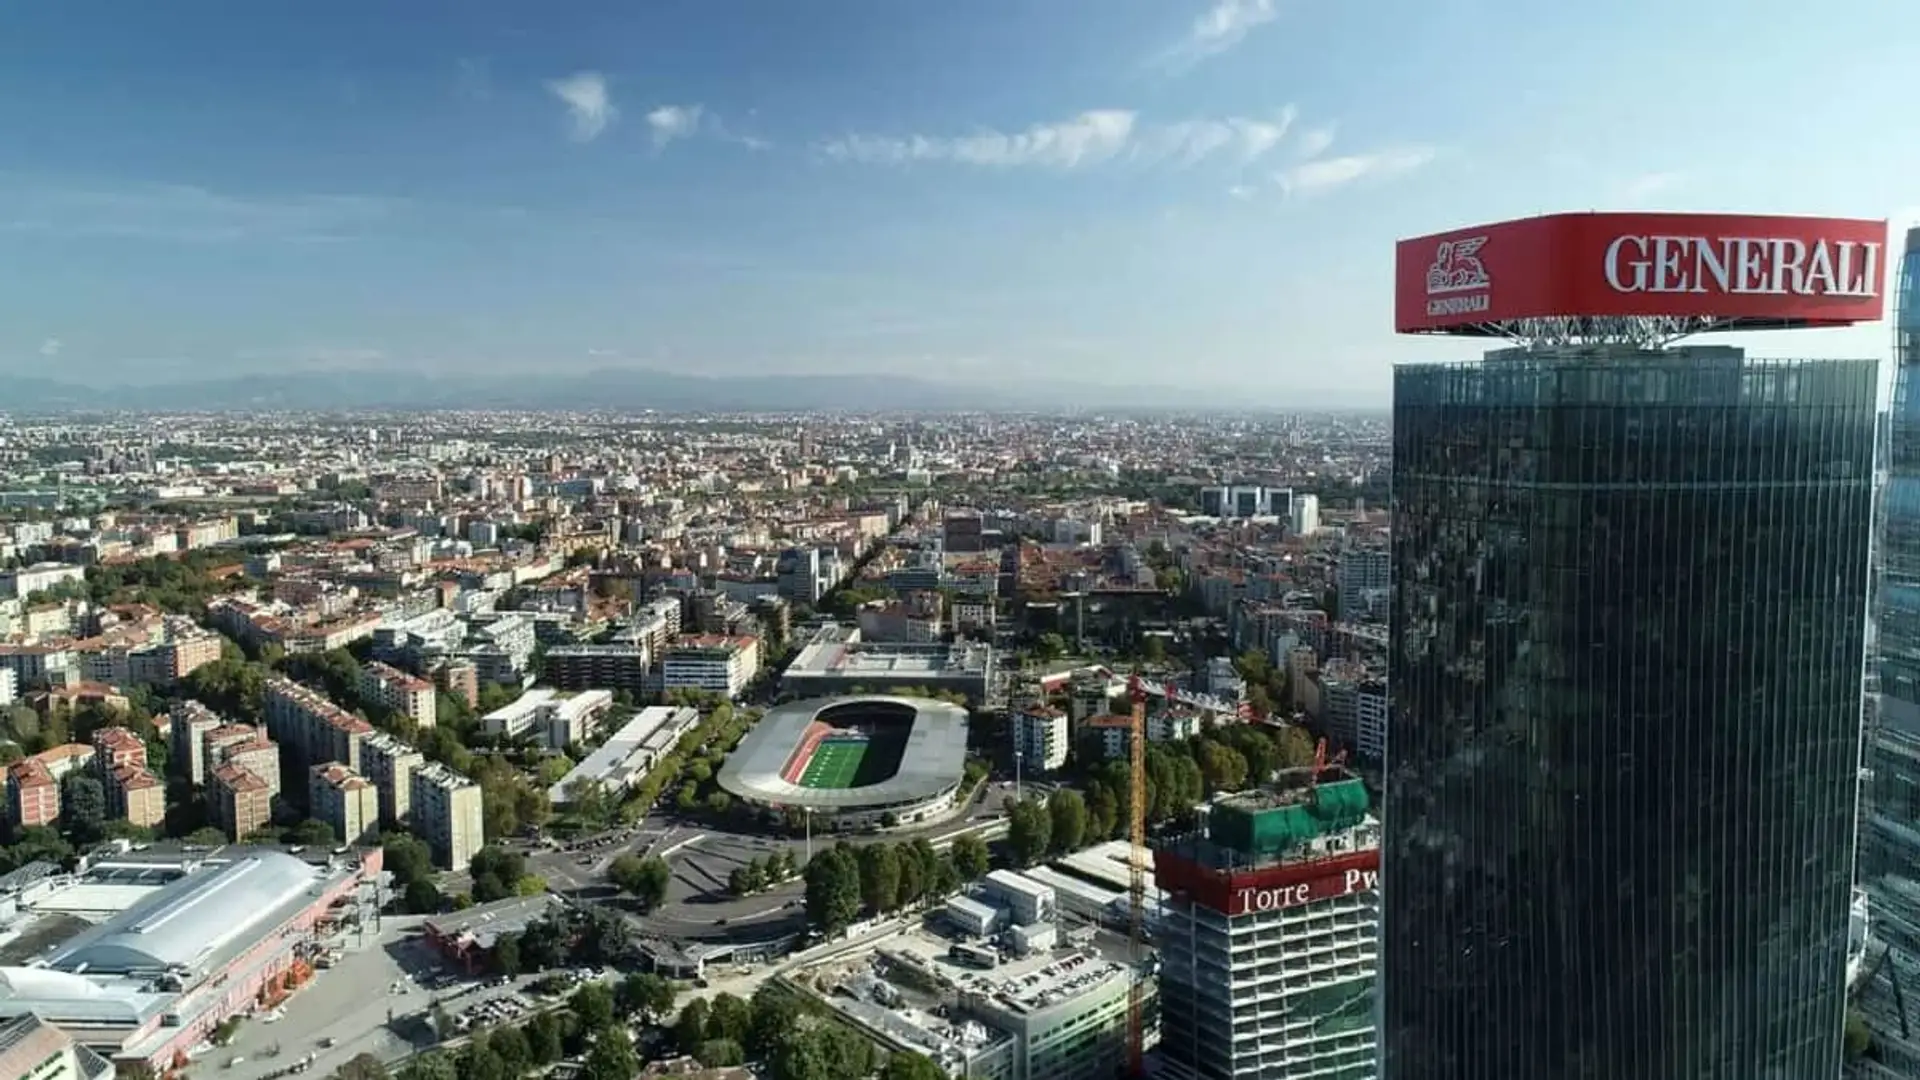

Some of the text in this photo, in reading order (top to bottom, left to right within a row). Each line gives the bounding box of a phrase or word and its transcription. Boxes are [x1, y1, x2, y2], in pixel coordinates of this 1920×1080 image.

[1604, 235, 1881, 297] GENERALI
[1427, 294, 1490, 316] GENERALI
[1238, 883, 1309, 914] Torre
